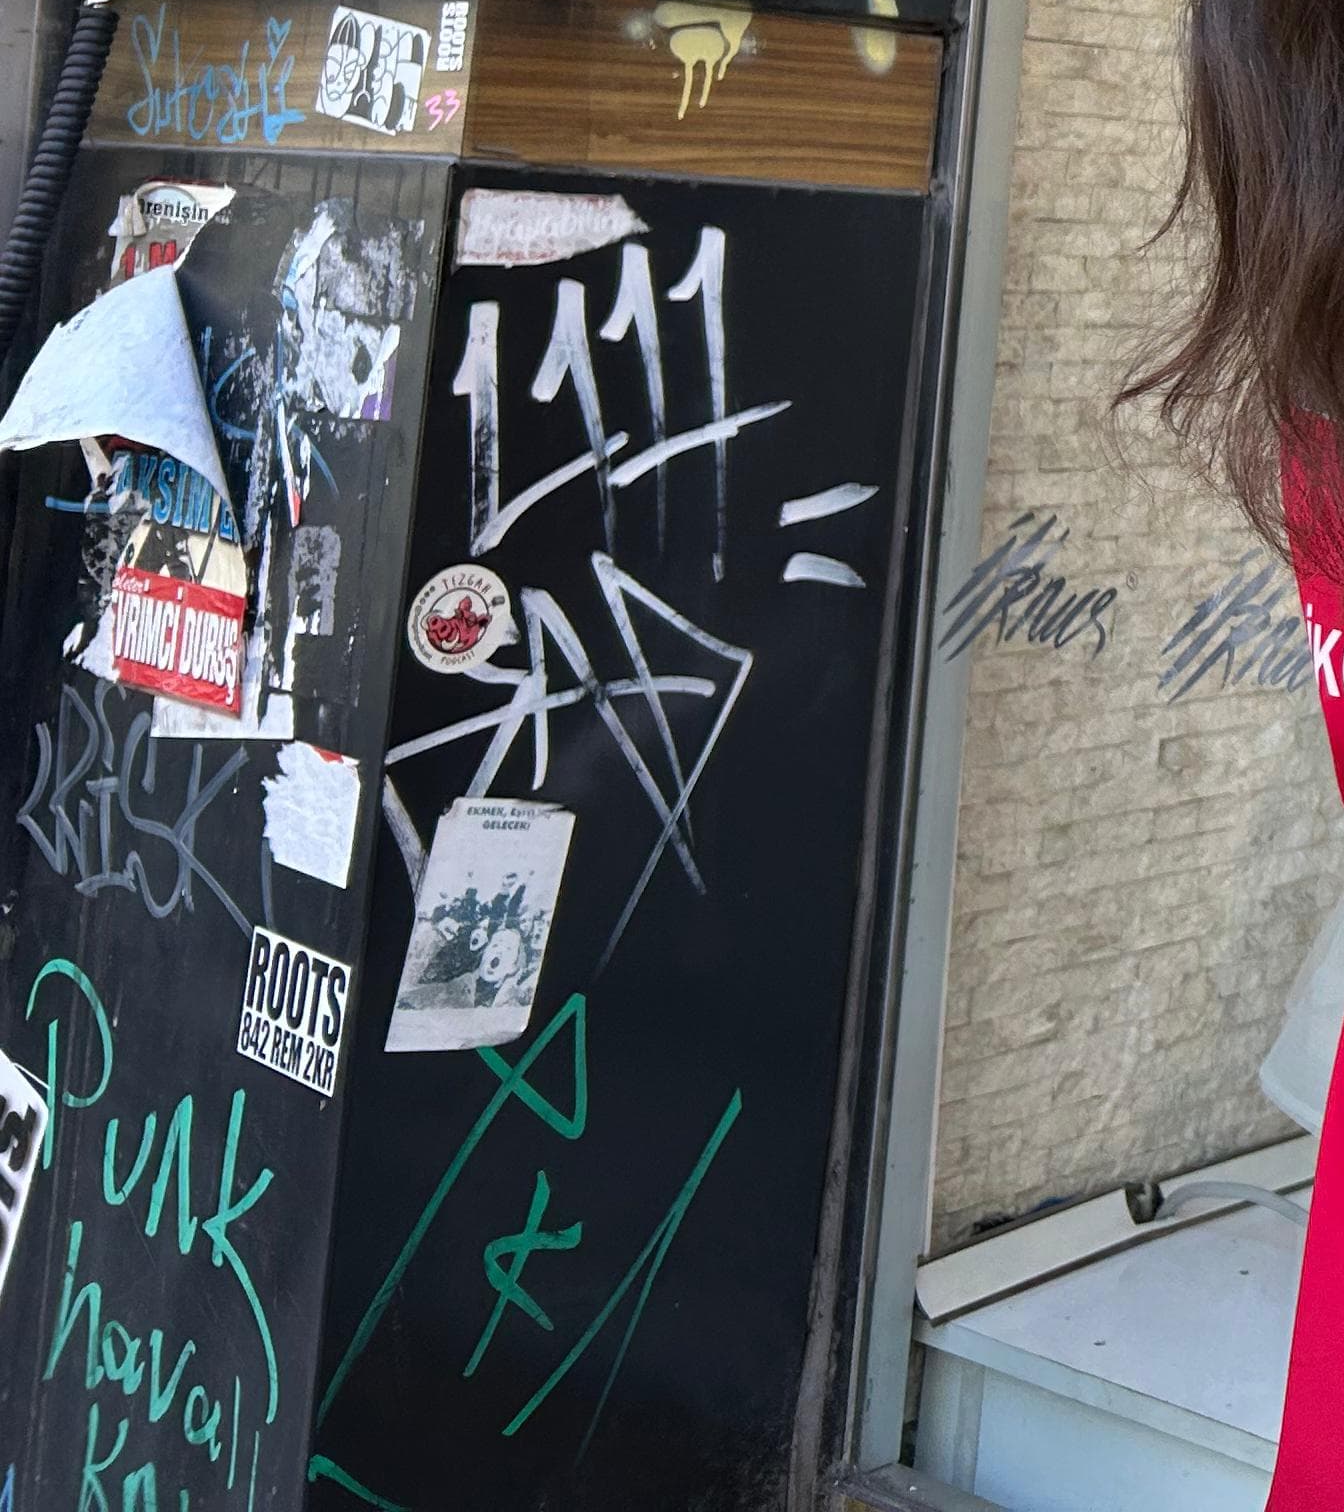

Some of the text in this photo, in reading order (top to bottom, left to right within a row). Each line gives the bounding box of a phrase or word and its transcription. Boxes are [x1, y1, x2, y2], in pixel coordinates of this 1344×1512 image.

[112, 578, 184, 672] VRİMCİ
[245, 933, 348, 1046] ROOTS
[241, 1012, 335, 1093] 842 REM 2KR
